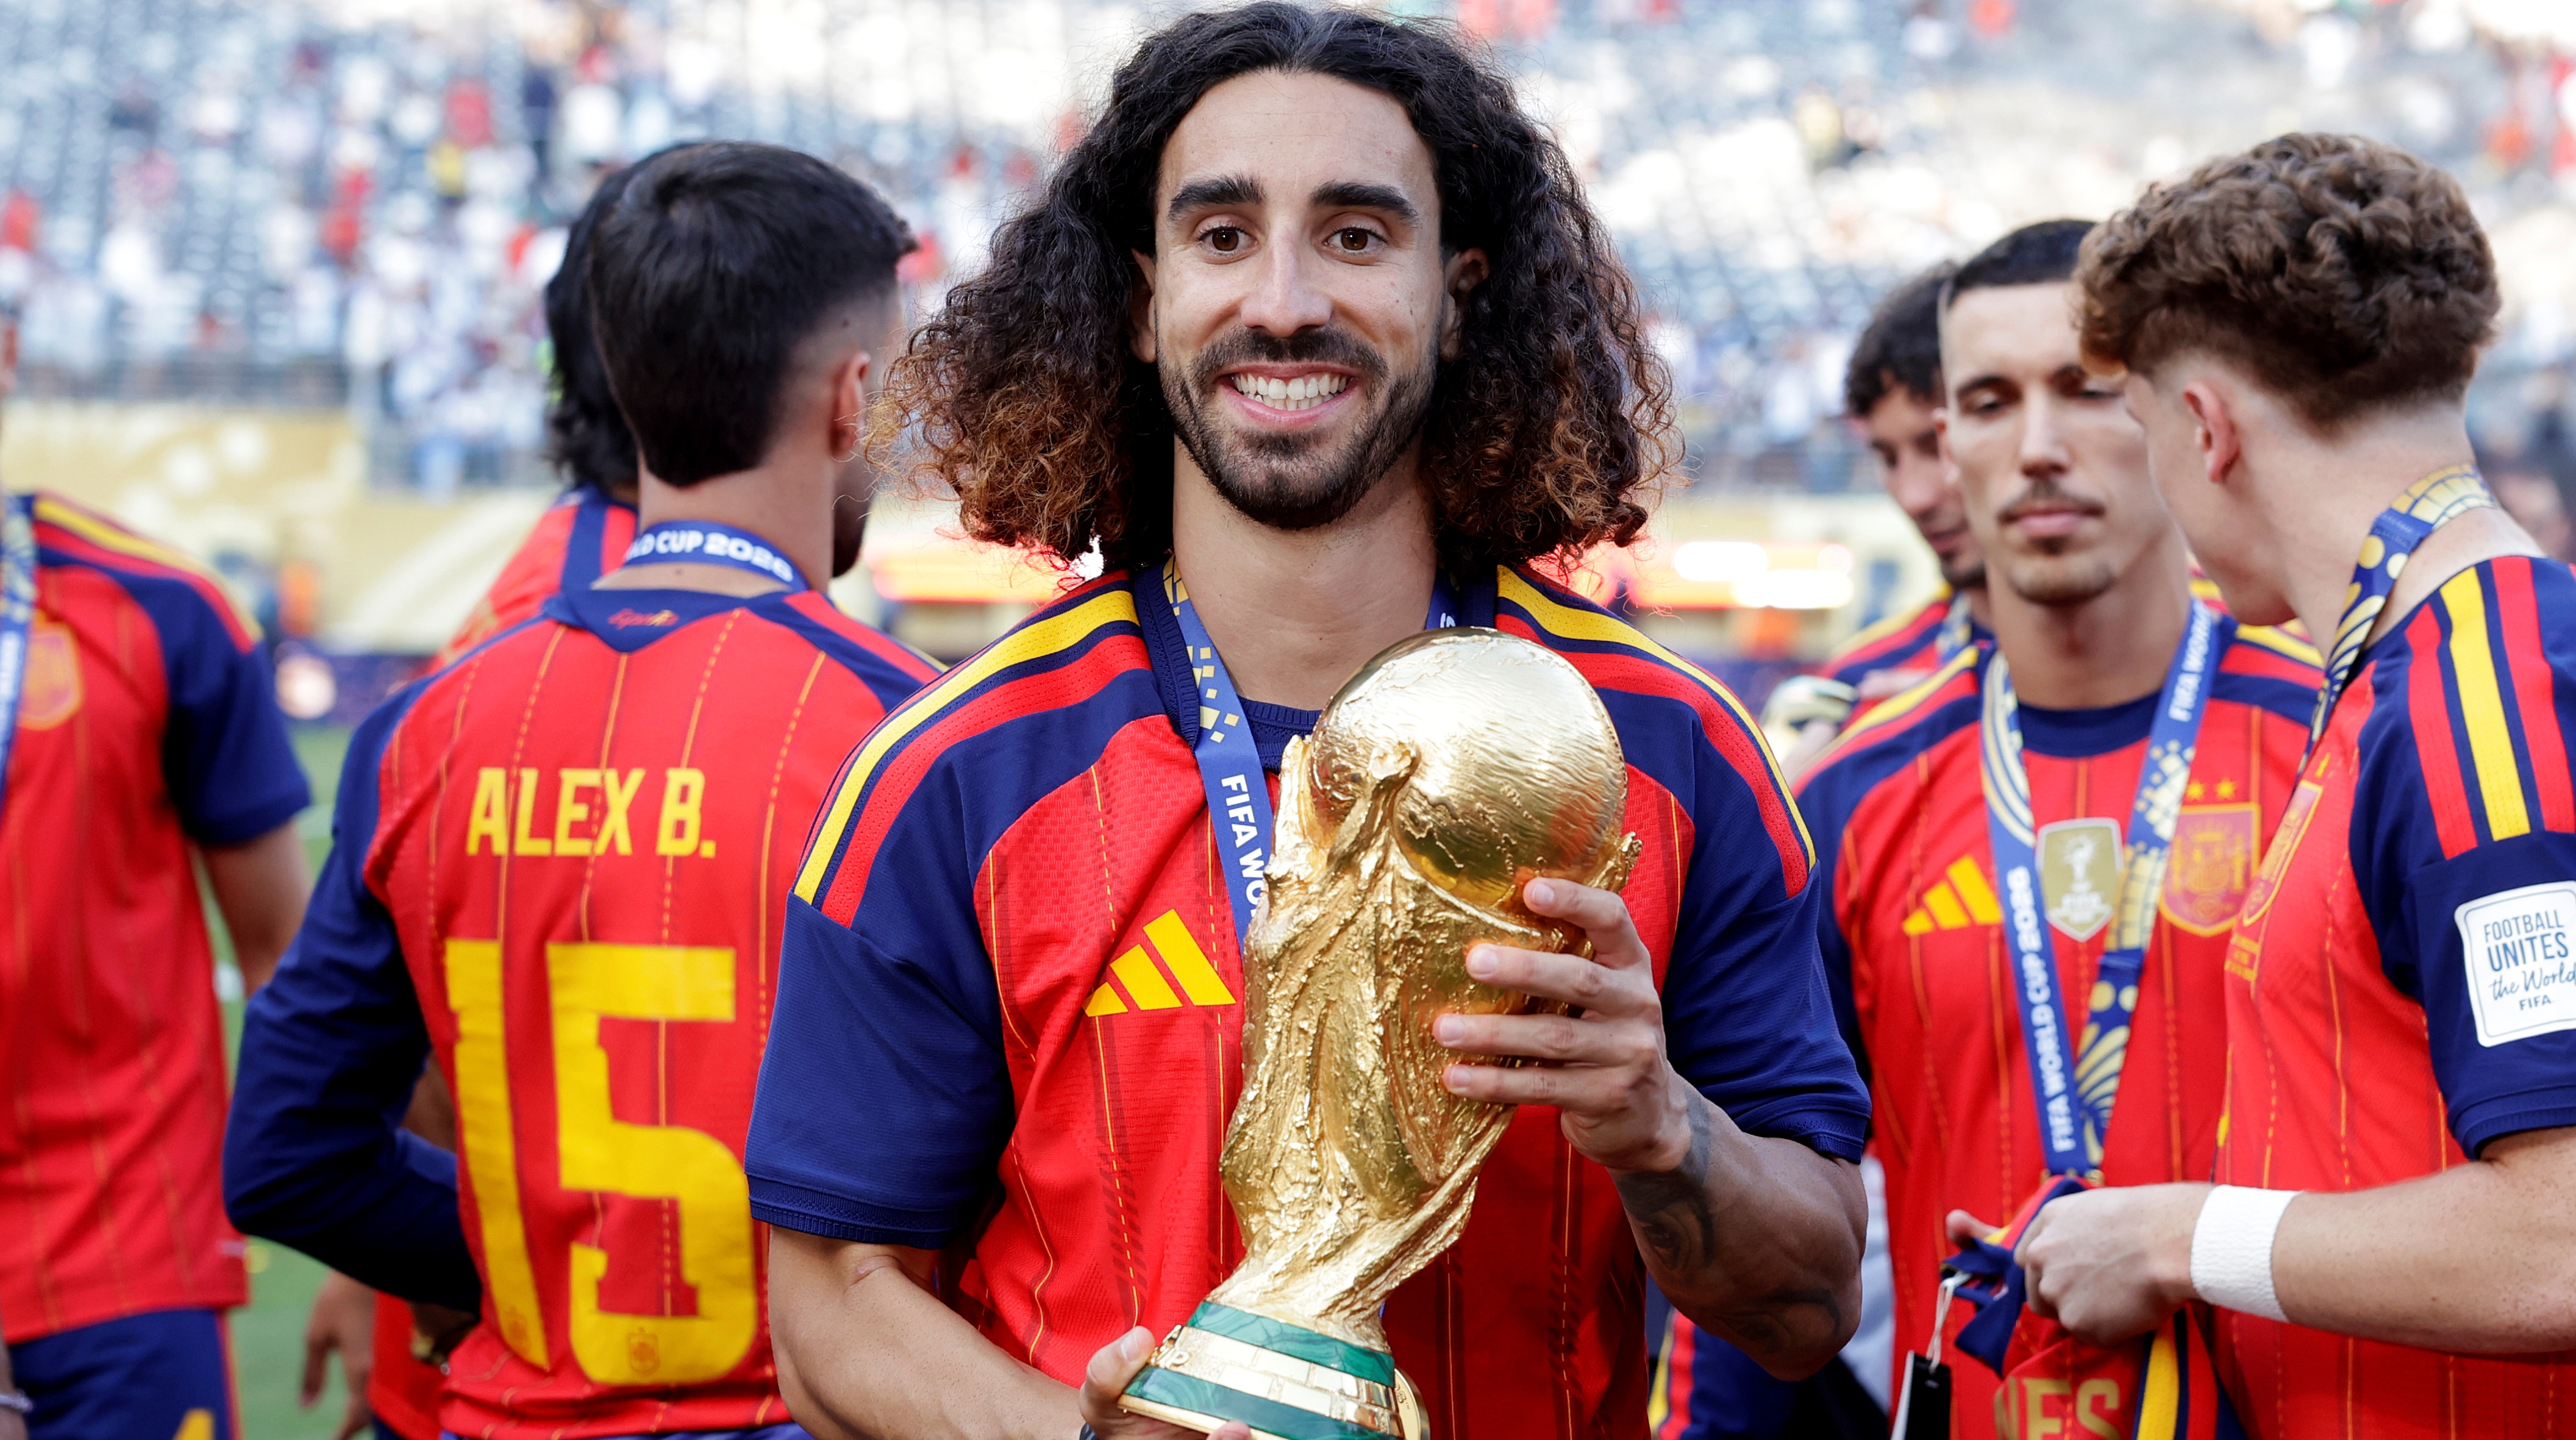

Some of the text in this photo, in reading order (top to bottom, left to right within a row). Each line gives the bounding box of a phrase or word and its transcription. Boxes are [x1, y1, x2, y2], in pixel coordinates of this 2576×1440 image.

[656, 530, 704, 554] CUP
[703, 532, 793, 583] 2026
[466, 767, 716, 858] ALEX B.
[1221, 774, 1265, 917] FIFA WO
[2483, 910, 2564, 943] FOOTBALL
[2487, 932, 2569, 972] UNITES
[2488, 961, 2576, 1000] the World
[2519, 994, 2552, 1011] FIFA
[2007, 866, 2076, 1152] FIFA WORLD CUP 2026
[445, 938, 757, 1385] 15
